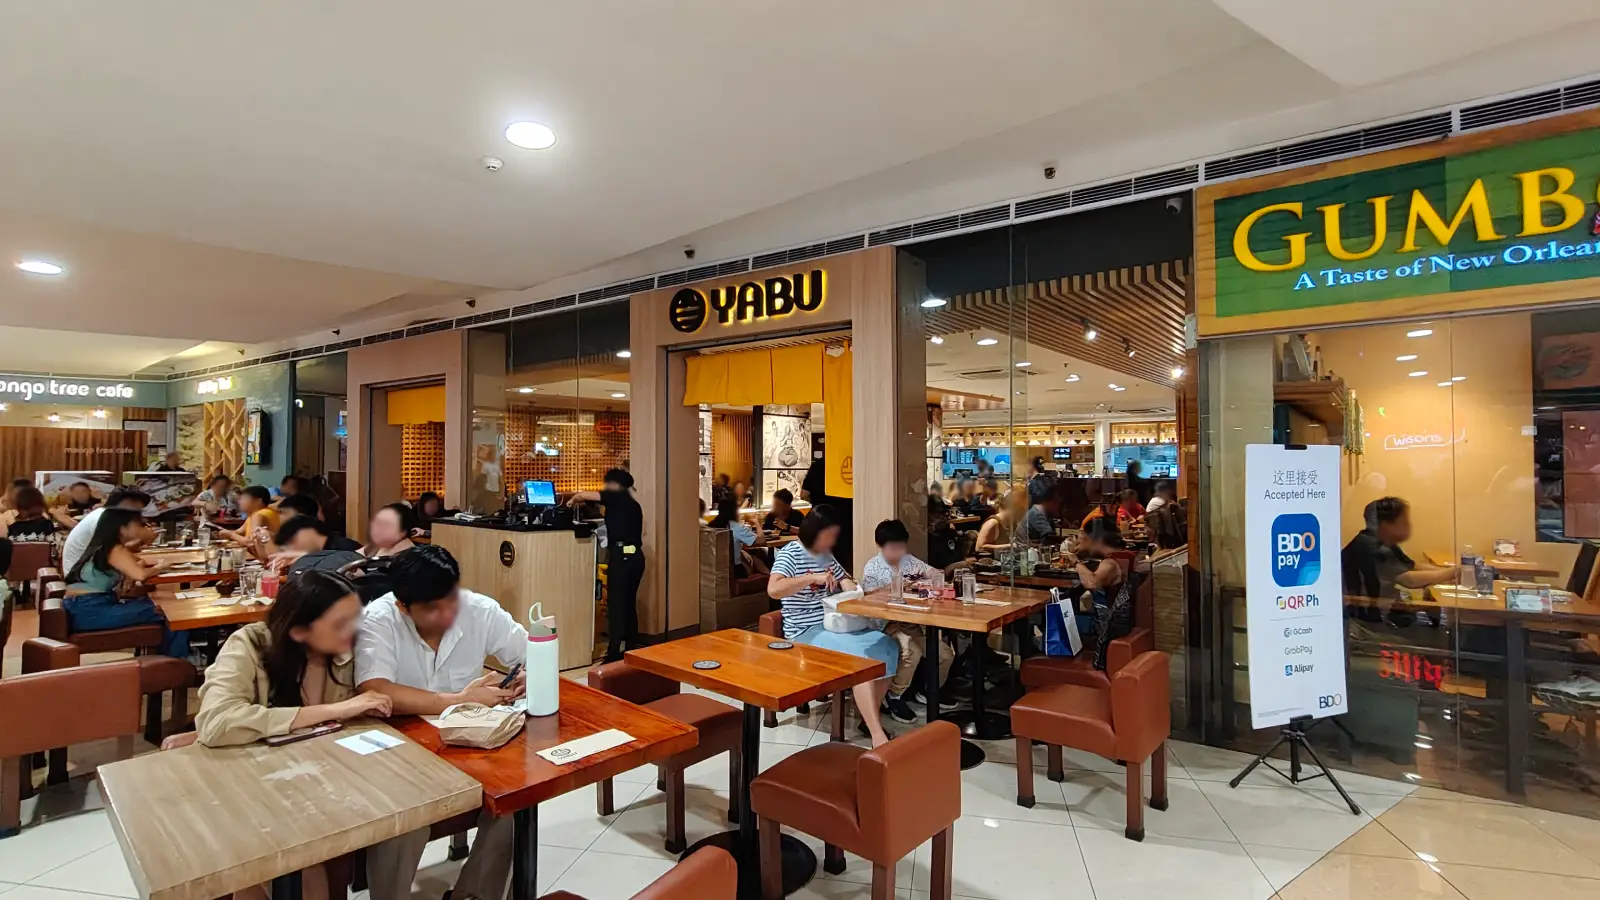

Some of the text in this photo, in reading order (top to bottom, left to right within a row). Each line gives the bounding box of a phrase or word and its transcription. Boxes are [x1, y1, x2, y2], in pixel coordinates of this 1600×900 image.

[1233, 167, 1600, 272] GUMB
[1293, 272, 1316, 290] A
[1320, 268, 1388, 286] Taste
[1395, 257, 1427, 277] of
[1429, 254, 1496, 273] New
[710, 269, 823, 324] YABU
[50, 380, 89, 396] tree
[96, 384, 133, 398] cafe
[1273, 470, 1318, 486] 这里接受
[1264, 489, 1326, 501] Accepted Here
[1278, 532, 1315, 553] BDO
[1278, 554, 1300, 570] pay
[1293, 627, 1313, 636] GCash
[1294, 664, 1314, 674] Alipay
[1319, 693, 1342, 709] BDO
